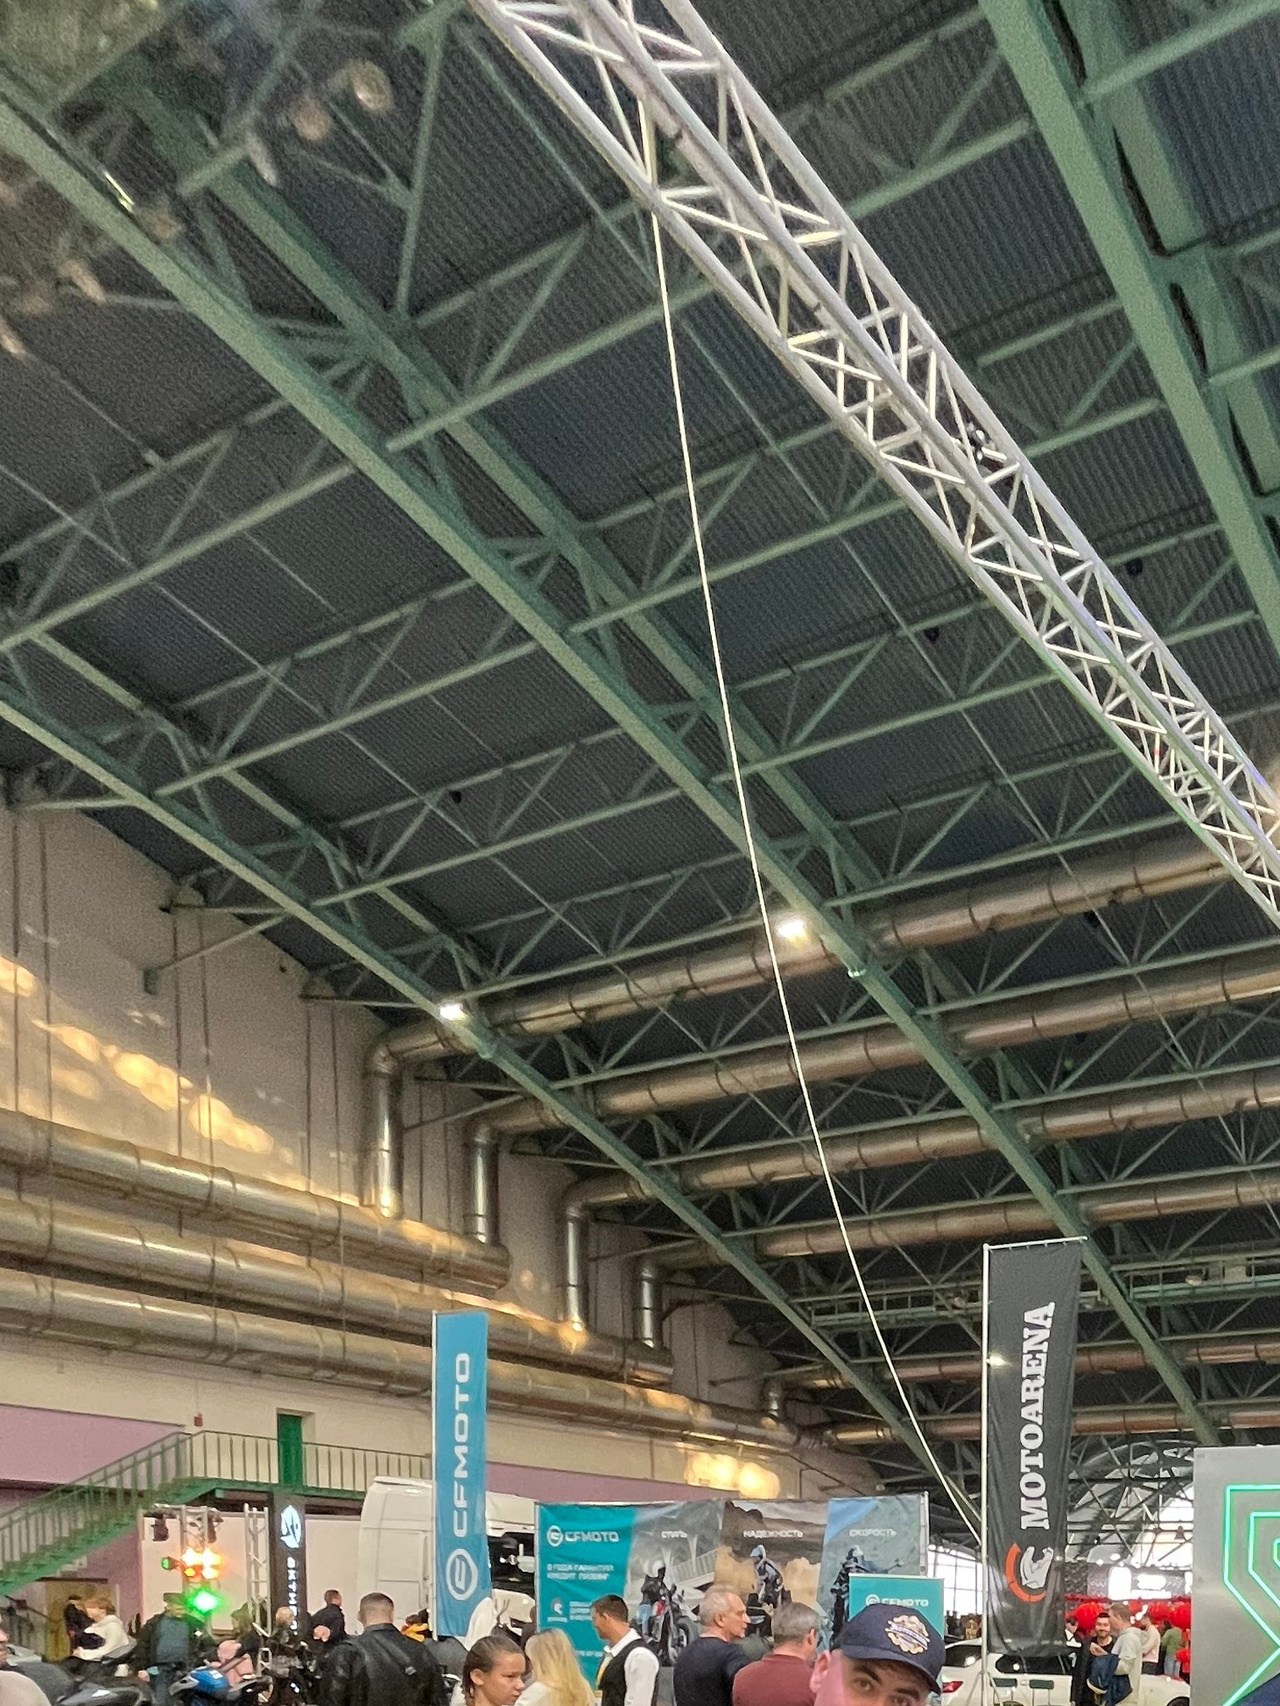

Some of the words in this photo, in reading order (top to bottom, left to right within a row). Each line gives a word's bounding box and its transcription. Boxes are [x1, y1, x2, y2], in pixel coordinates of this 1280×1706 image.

[1019, 1301, 1056, 1530] MOTOARENA
[453, 1352, 470, 1538] CFMOTO
[565, 1531, 619, 1542] CFMOTO
[849, 1529, 897, 1538] СКОРОСТЬ
[881, 1598, 929, 1606] CFMOTO
